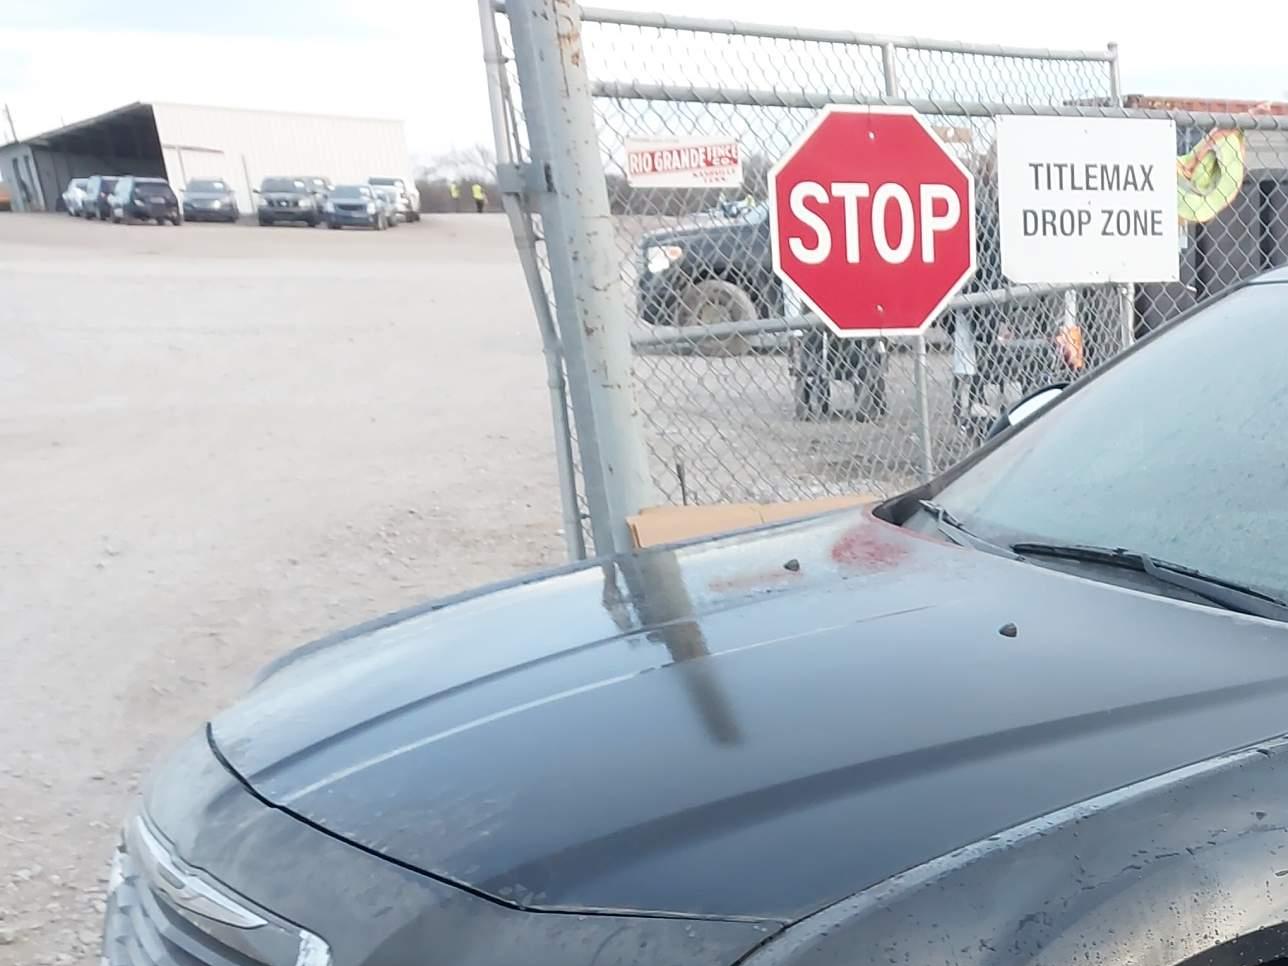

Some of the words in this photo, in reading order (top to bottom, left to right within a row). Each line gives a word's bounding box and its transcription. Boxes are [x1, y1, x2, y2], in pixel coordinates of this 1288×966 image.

[629, 151, 653, 174] RIO
[653, 147, 706, 172] GRANDE
[1028, 162, 1156, 192] TITLEMAX
[788, 181, 961, 265] STOP
[1021, 209, 1094, 239] DROP
[1101, 208, 1164, 237] ZONE
